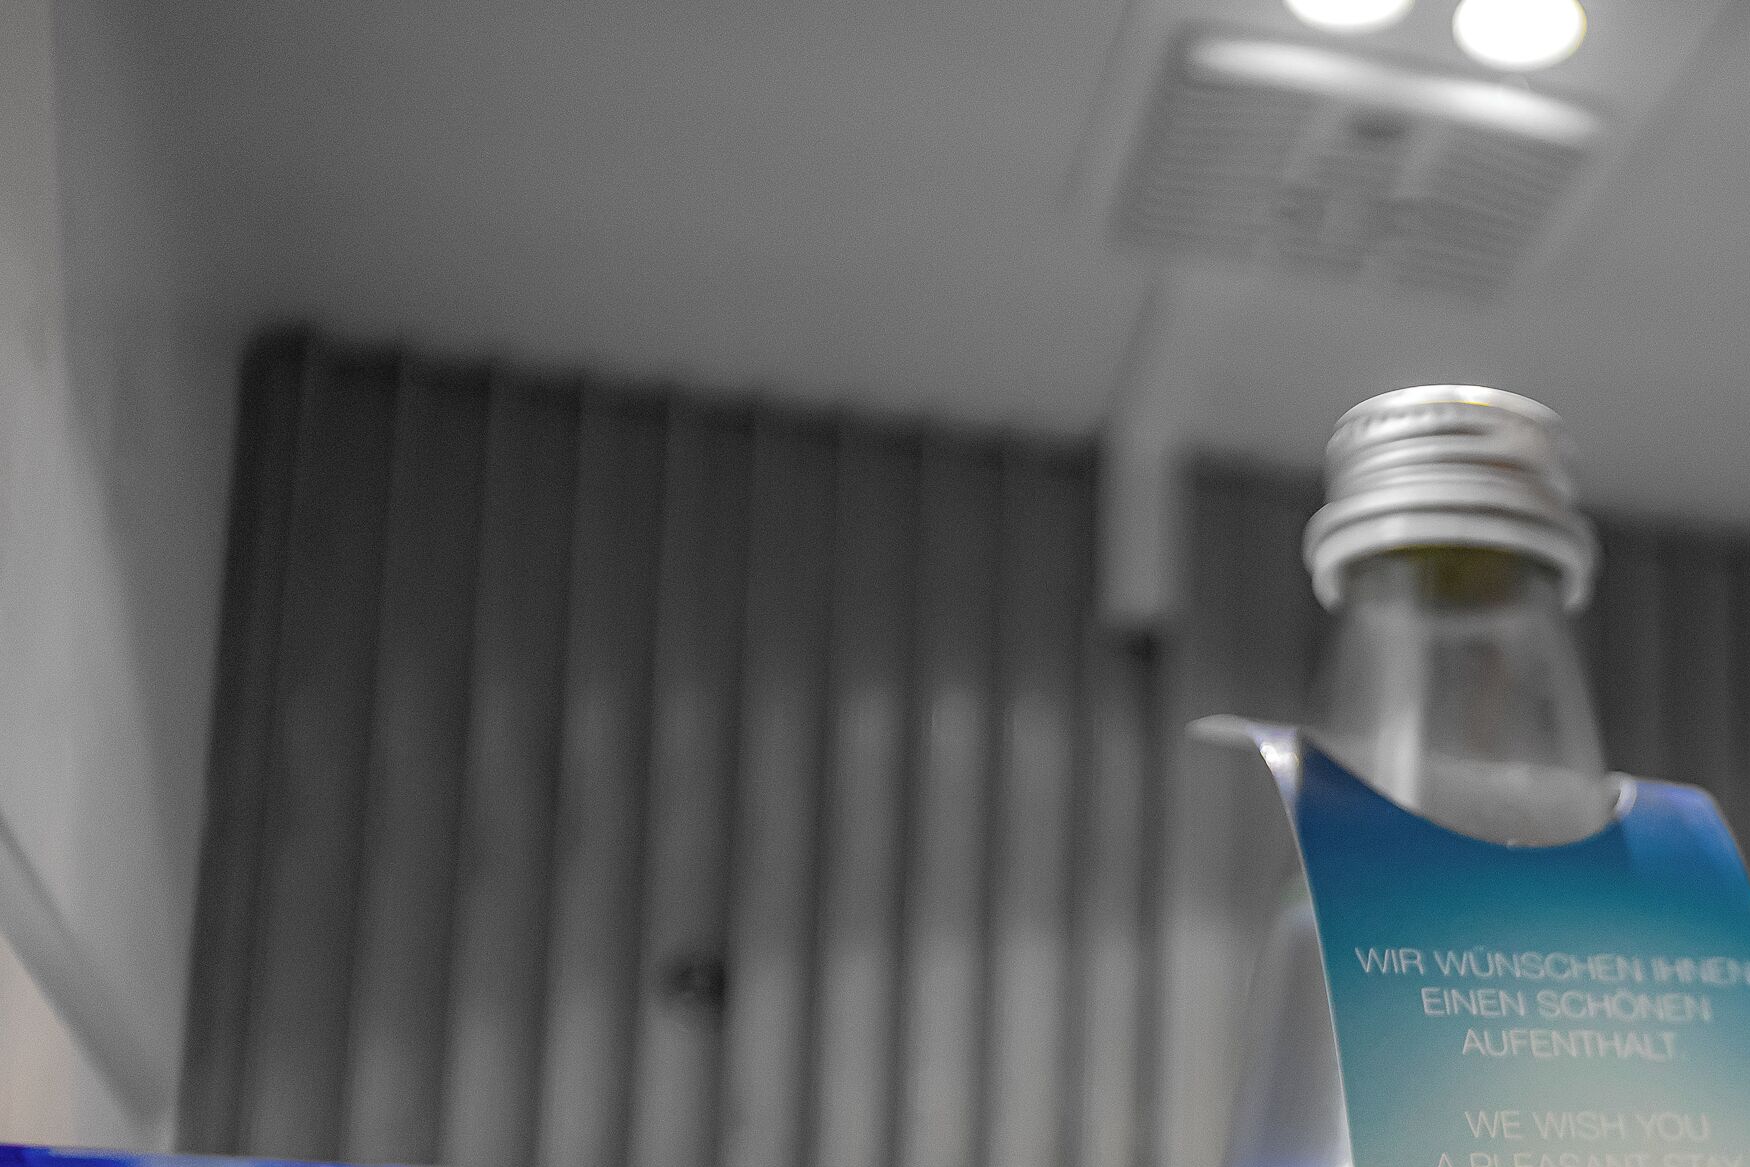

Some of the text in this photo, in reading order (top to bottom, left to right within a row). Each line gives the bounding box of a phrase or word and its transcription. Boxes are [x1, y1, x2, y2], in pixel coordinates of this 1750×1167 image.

[1355, 947, 1424, 976] WIR
[1435, 945, 1643, 983] WÜNSCHEN
[1421, 987, 1712, 1022] EINEN SCHÖNEN
[1465, 1110, 1711, 1143] WE WISH YOU
